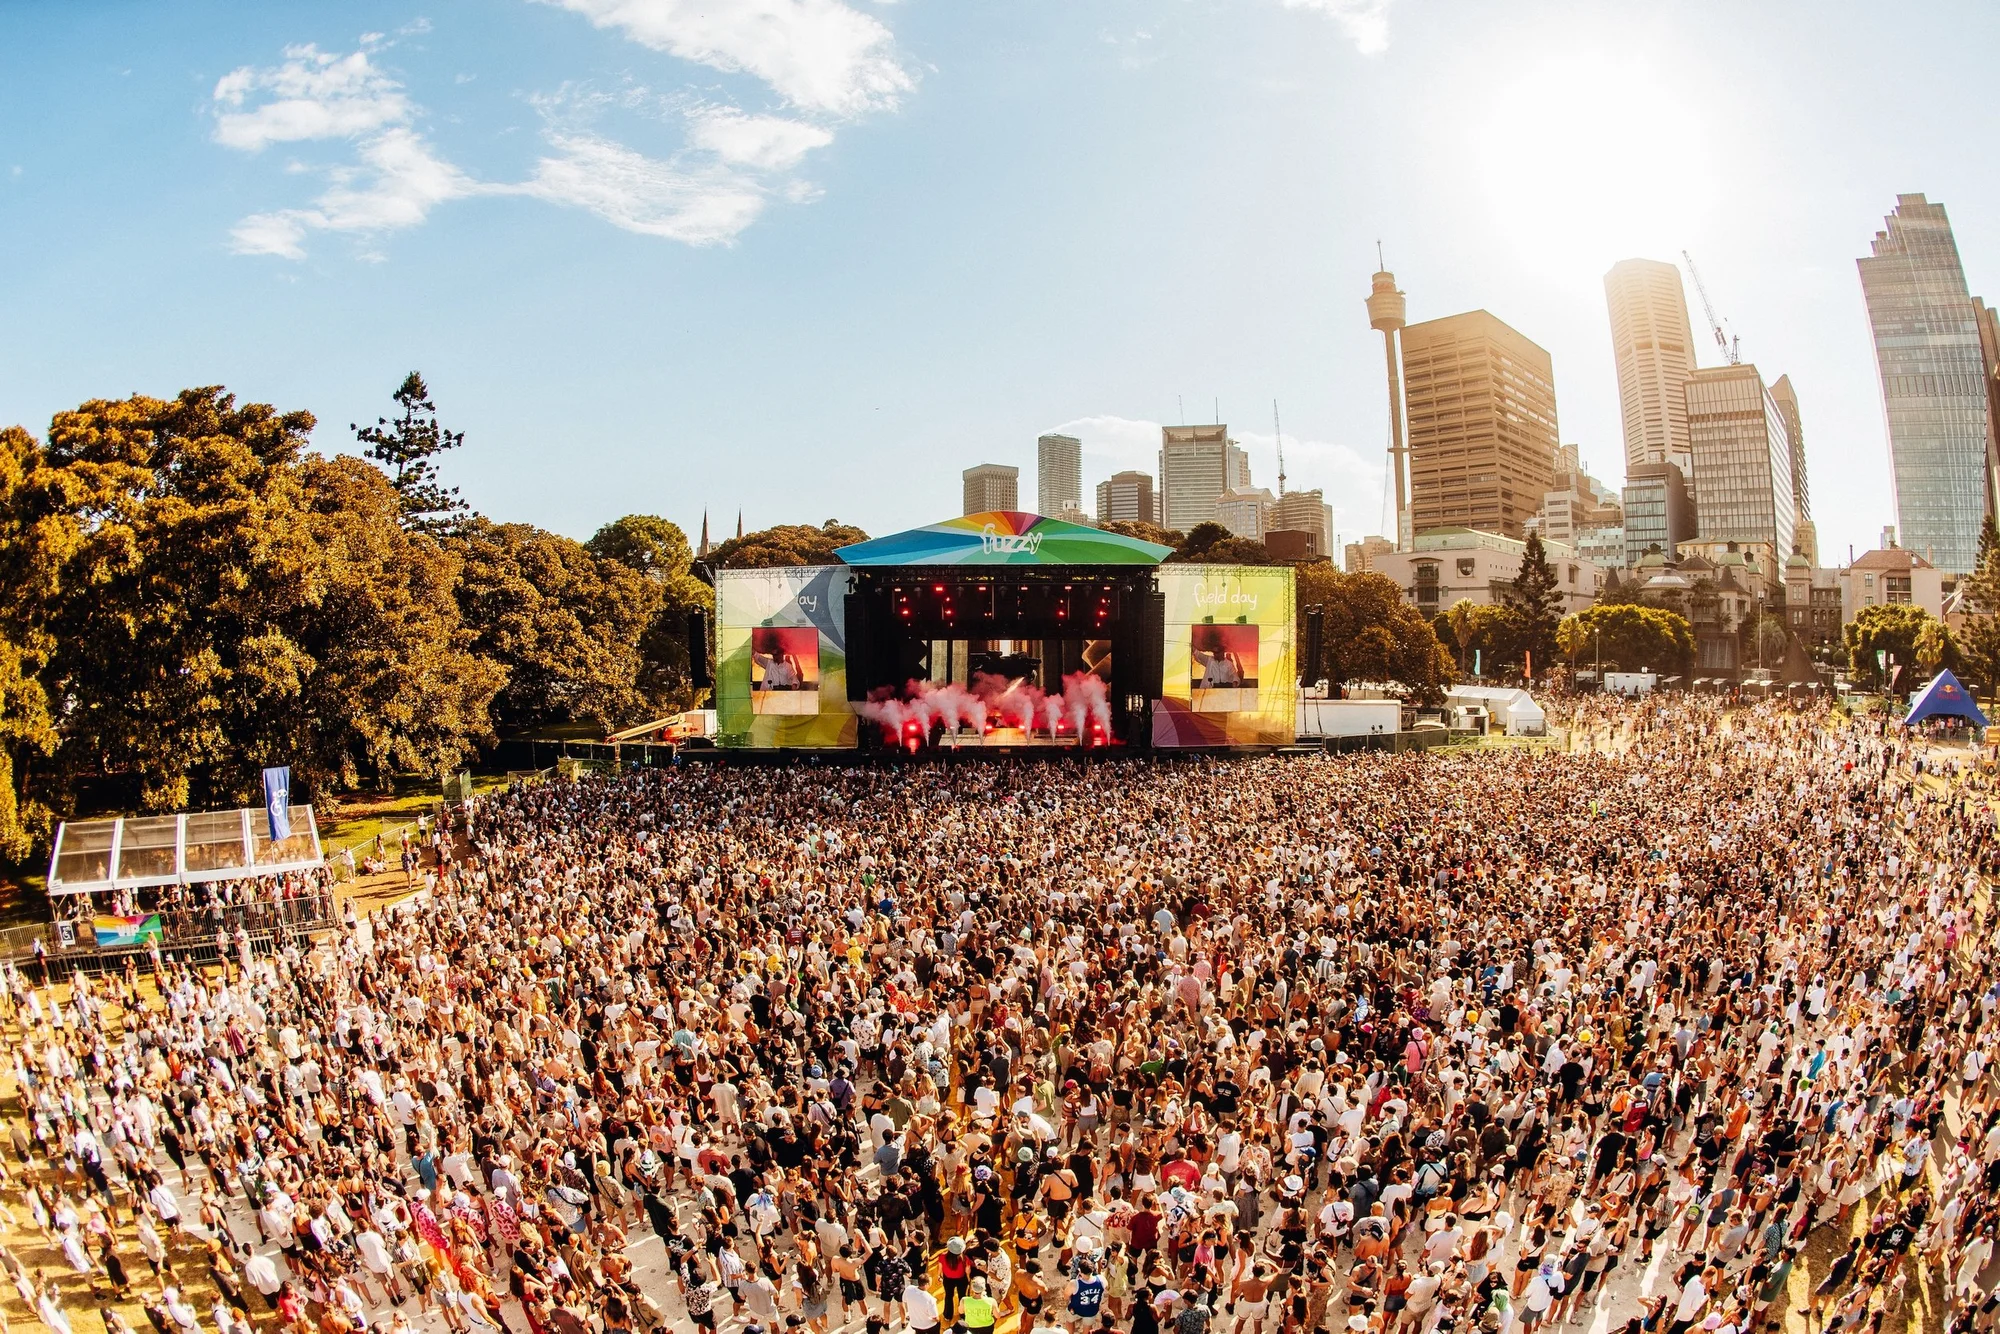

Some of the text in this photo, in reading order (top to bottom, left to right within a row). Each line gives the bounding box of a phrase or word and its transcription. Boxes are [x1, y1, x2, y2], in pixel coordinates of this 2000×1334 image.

[980, 523, 1043, 555] fuzzy
[1192, 583, 1258, 611] field day
[115, 924, 140, 937] VIP
[1080, 1294, 1100, 1305] 34
